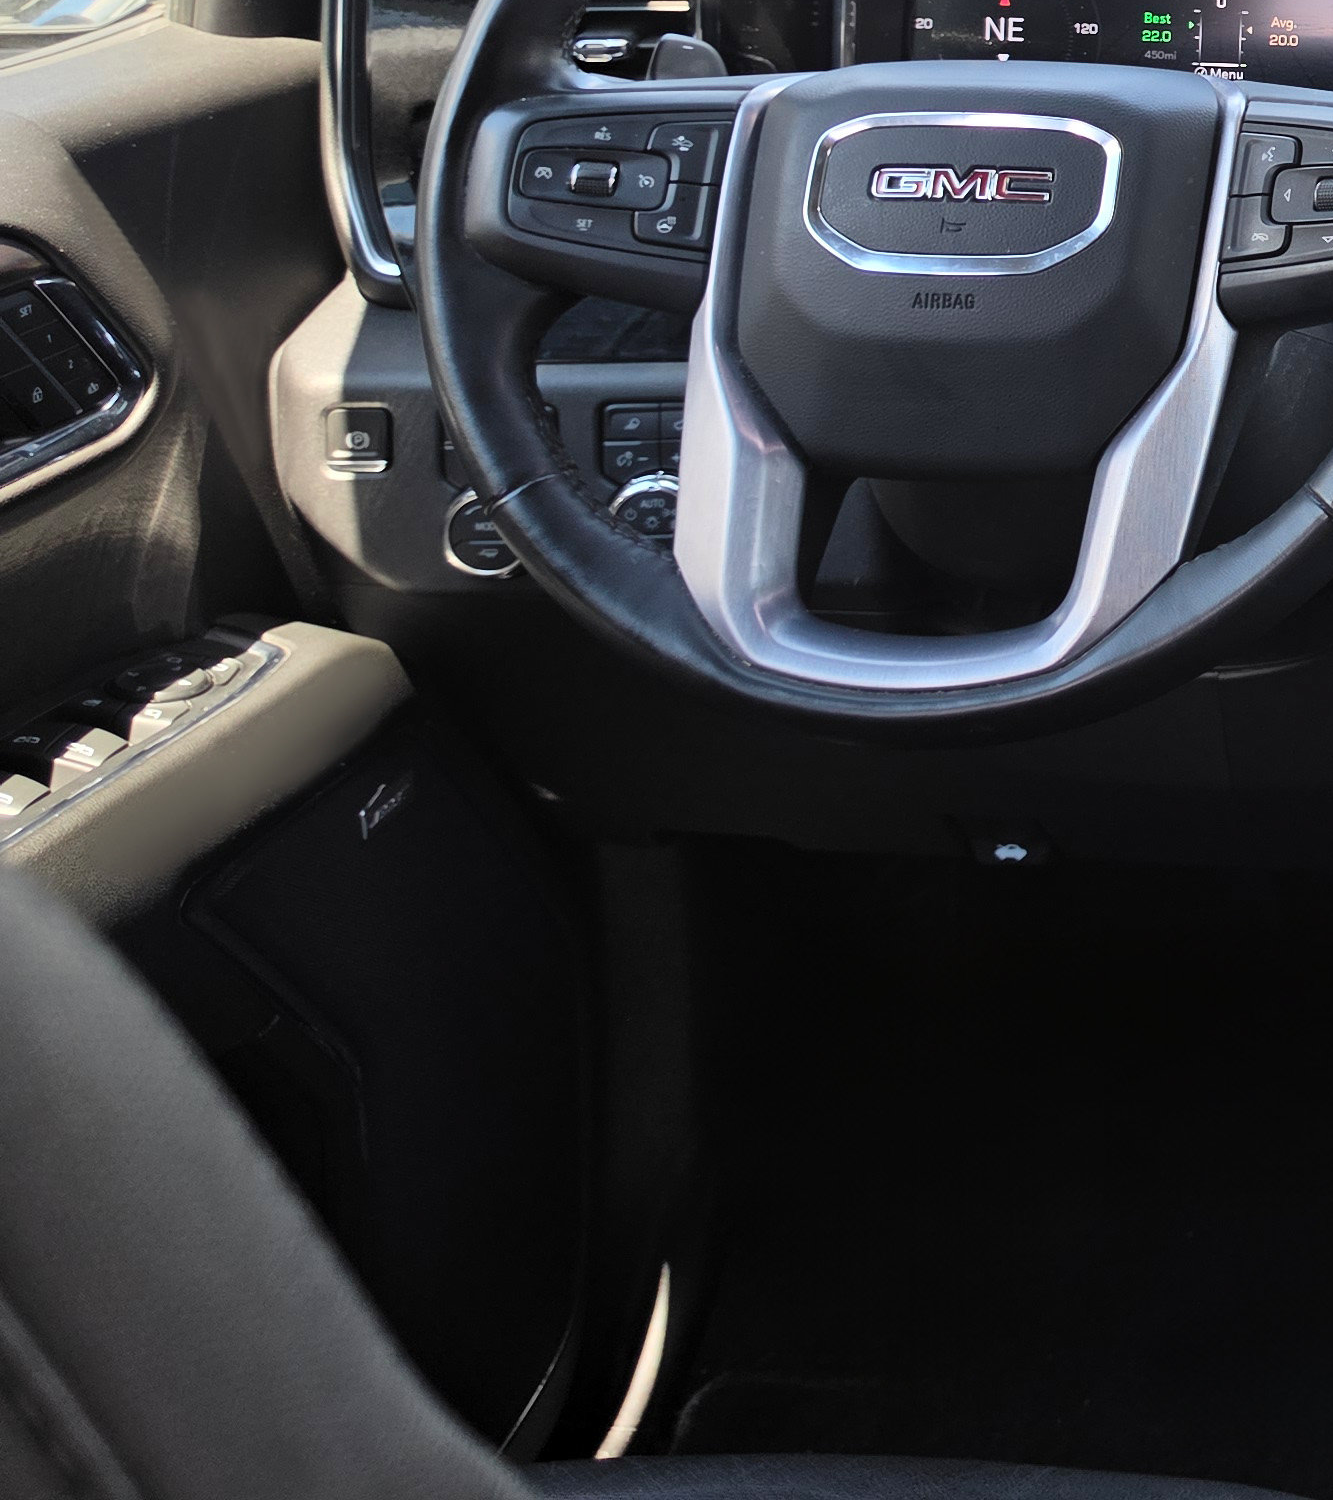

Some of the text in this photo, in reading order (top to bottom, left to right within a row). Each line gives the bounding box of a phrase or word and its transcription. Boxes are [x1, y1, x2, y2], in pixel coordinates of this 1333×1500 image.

[914, 17, 934, 30] 20
[1143, 11, 1172, 26] Best
[1270, 16, 1298, 30] Avg.
[984, 16, 1026, 43] NE
[1073, 22, 1099, 35] 120
[1141, 29, 1172, 43] 22.0
[1268, 34, 1299, 48] 20.0
[1210, 67, 1244, 81] Menu
[871, 166, 1054, 202] GMC
[575, 218, 594, 229] SET
[911, 291, 976, 311] AIRBAG
[19, 303, 33, 319] SET
[640, 498, 667, 509] AUTO
